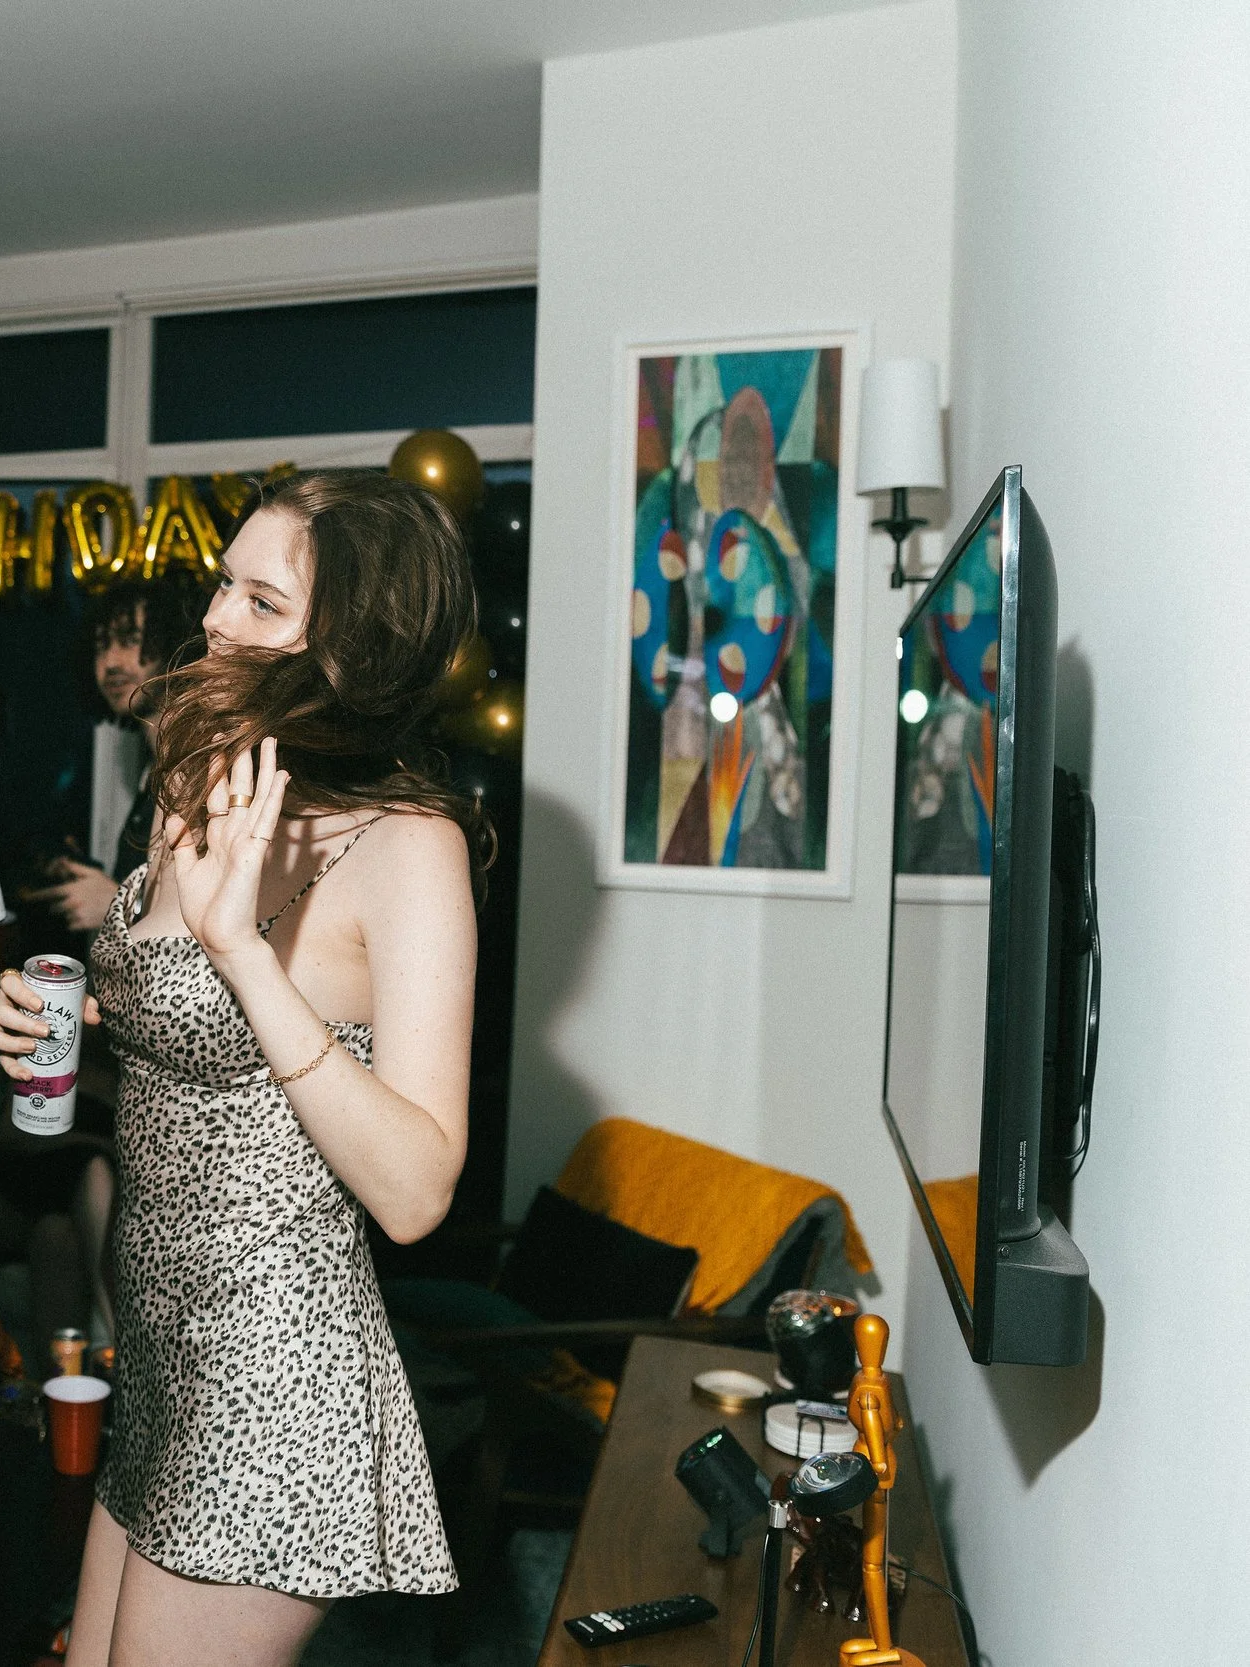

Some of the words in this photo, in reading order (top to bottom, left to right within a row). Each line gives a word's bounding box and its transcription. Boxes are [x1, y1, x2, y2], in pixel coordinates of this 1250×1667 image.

[43, 1001, 74, 1021] LAW
[47, 1029, 73, 1062] SELTZER
[26, 1083, 53, 1092] CHERRY
